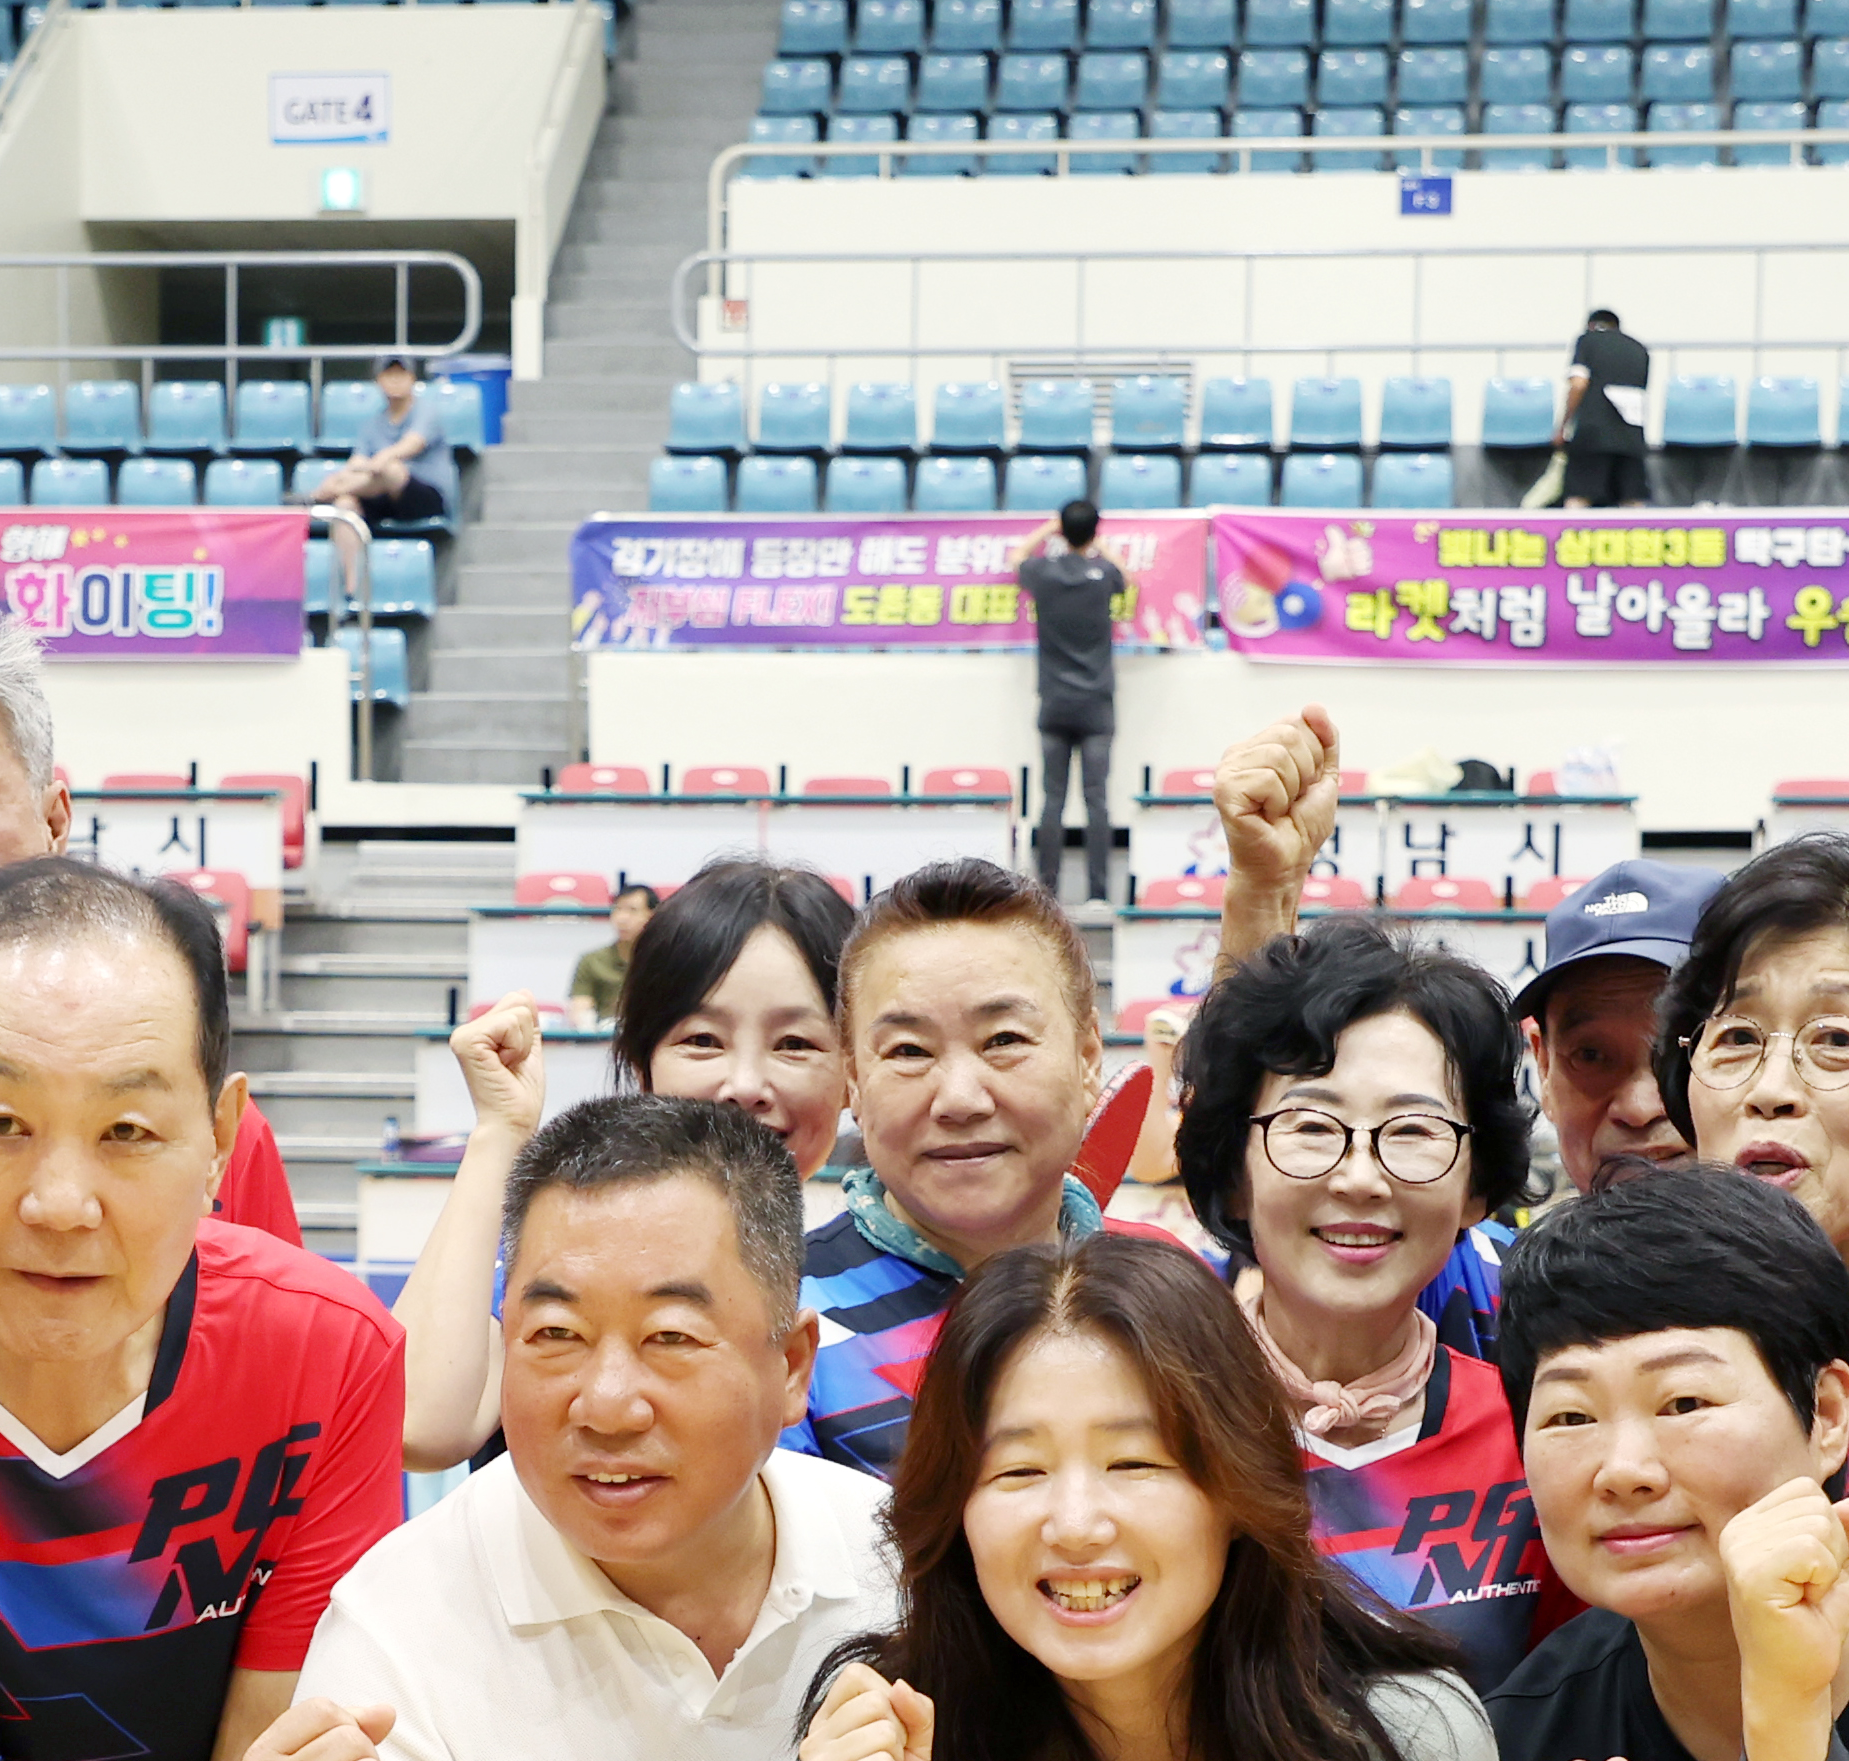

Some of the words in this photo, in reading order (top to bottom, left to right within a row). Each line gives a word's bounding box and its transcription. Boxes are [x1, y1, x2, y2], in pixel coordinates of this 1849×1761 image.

[284, 98, 347, 125] GATE
[354, 94, 373, 122] 4
[0, 524, 71, 564] 향해
[611, 536, 747, 579] 경기장에
[856, 534, 929, 577] 해도
[1438, 527, 1546, 568] 빛나는
[1554, 527, 1728, 568] 상대원3동
[8, 566, 222, 635] 화이팅!
[1345, 577, 1547, 648] 라켓처럼
[1565, 570, 1772, 650] 날아올라
